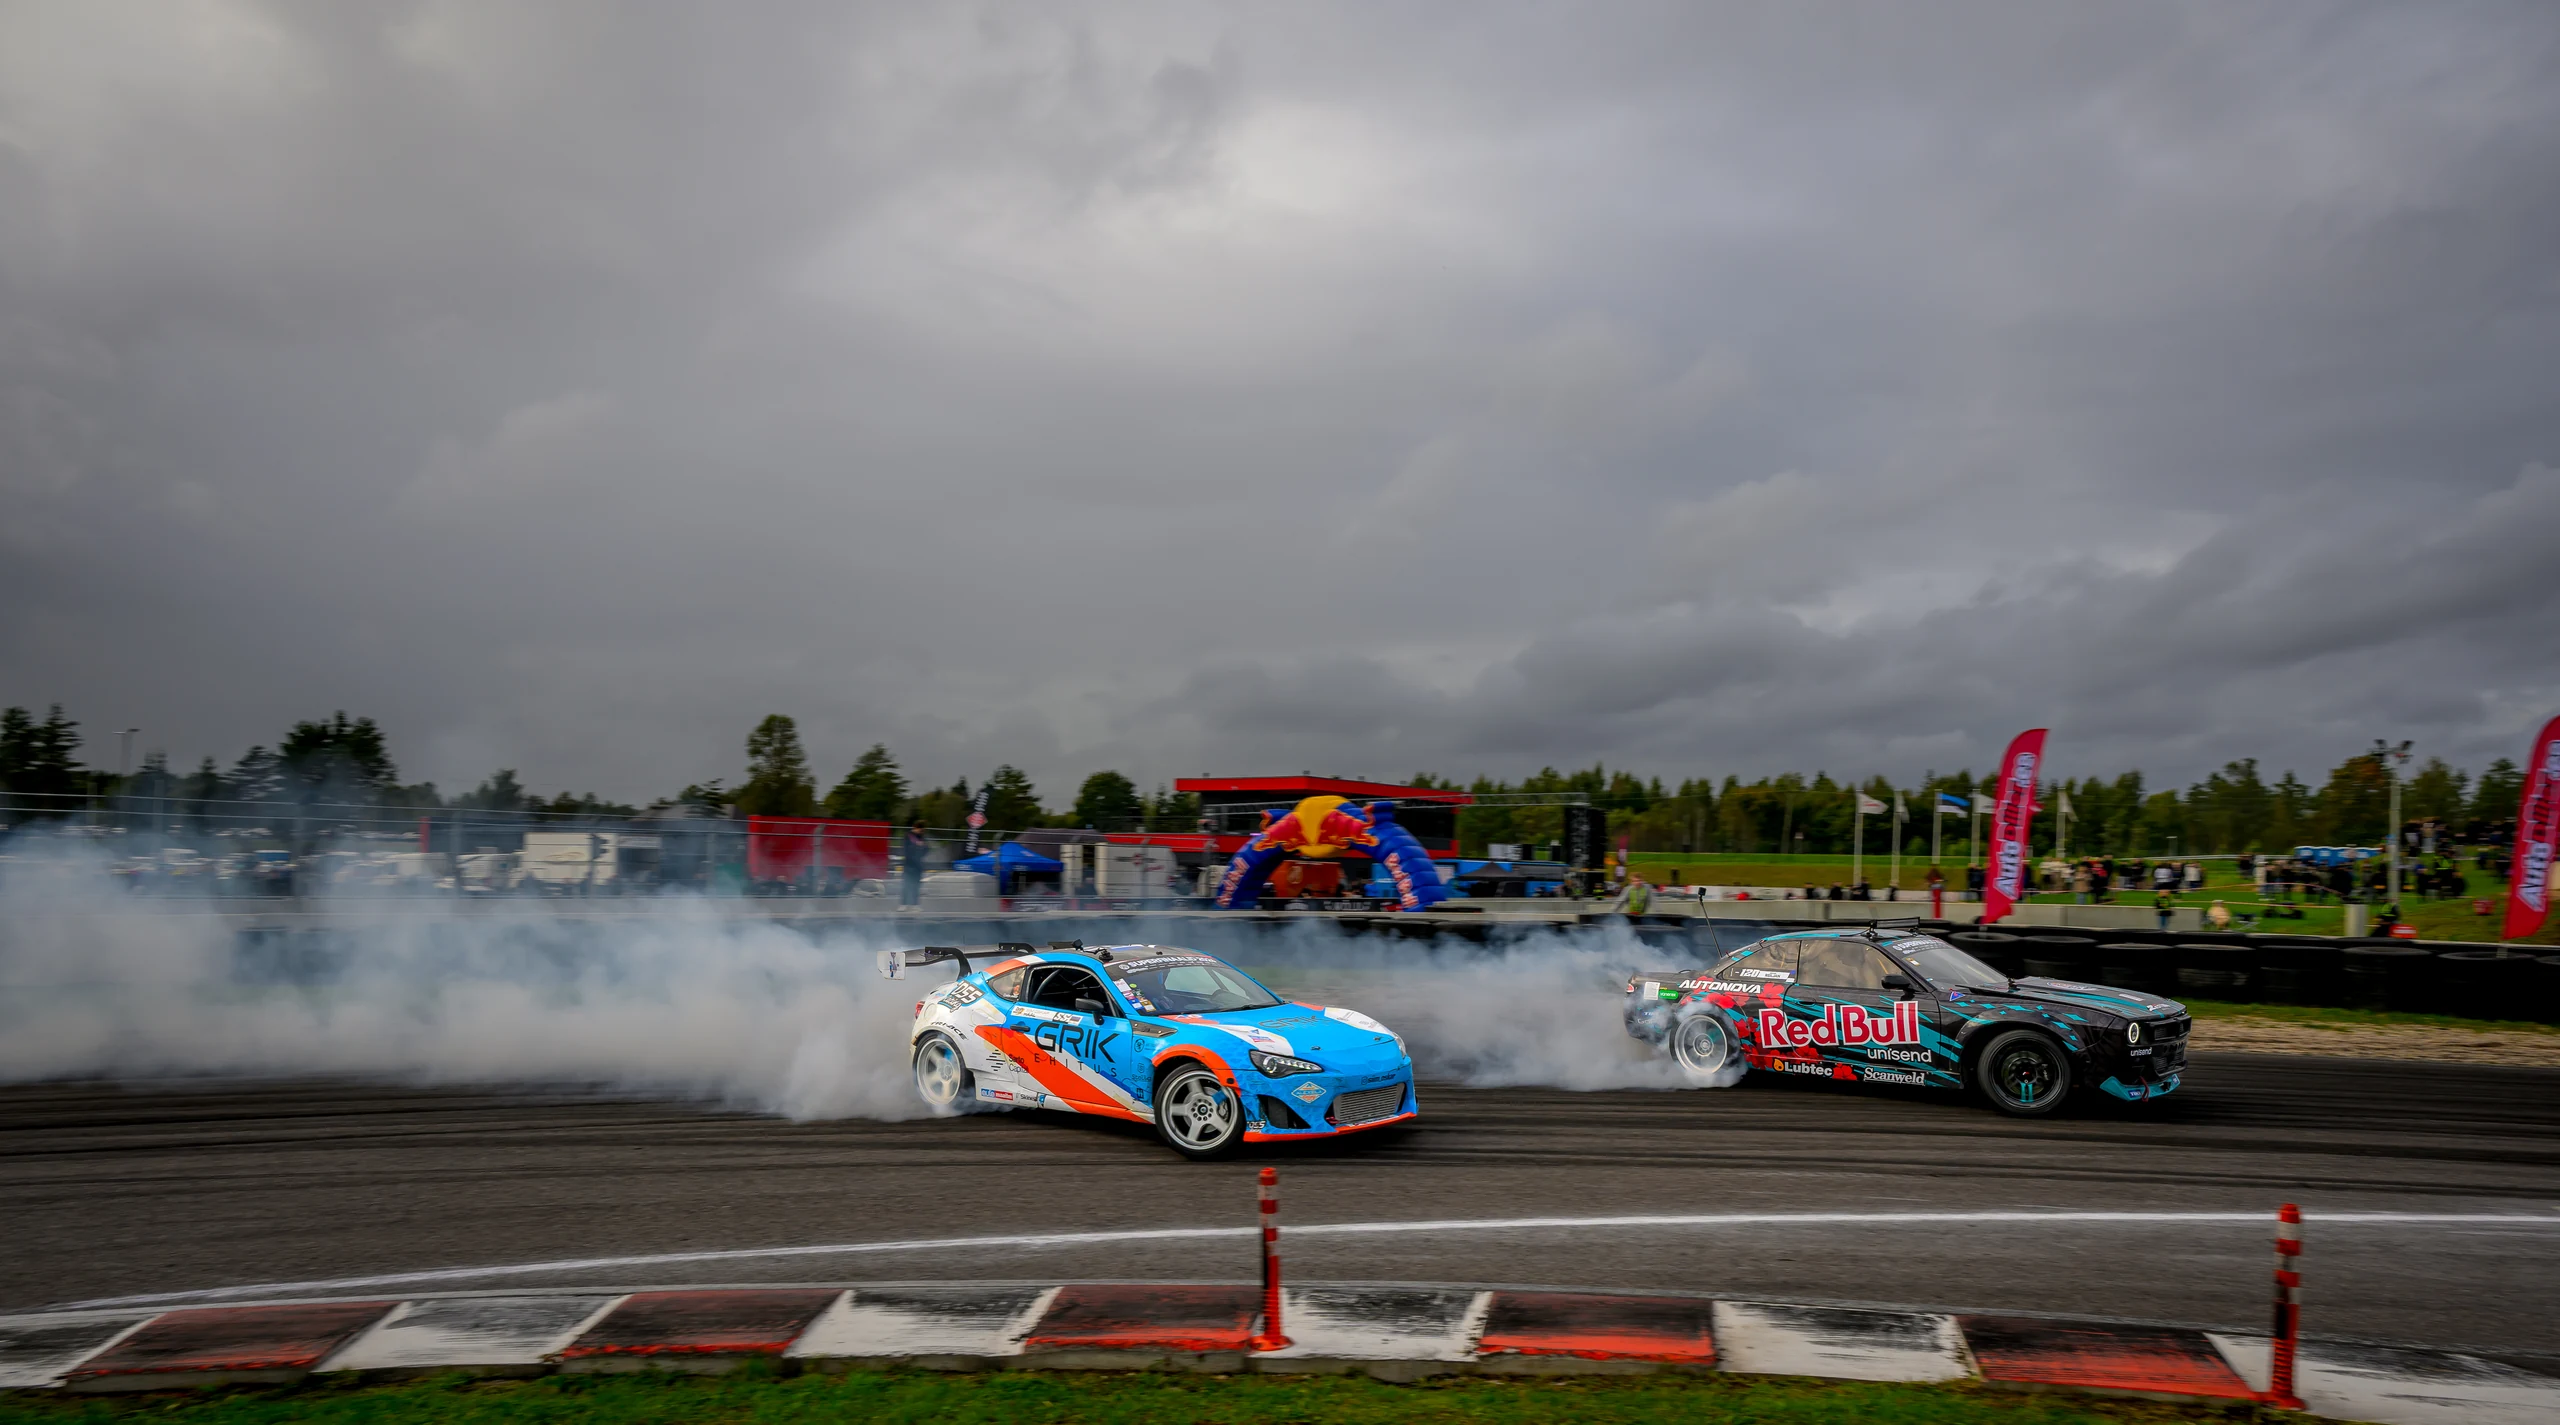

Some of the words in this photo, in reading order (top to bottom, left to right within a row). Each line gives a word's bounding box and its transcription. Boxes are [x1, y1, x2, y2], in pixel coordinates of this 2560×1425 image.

[1678, 979, 1762, 994] AUTONOVA
[1759, 1003, 1839, 1048] Red
[1840, 1001, 1920, 1046] Bull
[1035, 1022, 1119, 1063] GRIK
[1867, 1049, 1932, 1063] unisend
[2130, 1047, 2153, 1057] unisend
[1034, 1053, 1117, 1078] EHITUS
[1785, 1062, 1833, 1077] Lubtec
[1864, 1067, 1926, 1085] Scanweld
